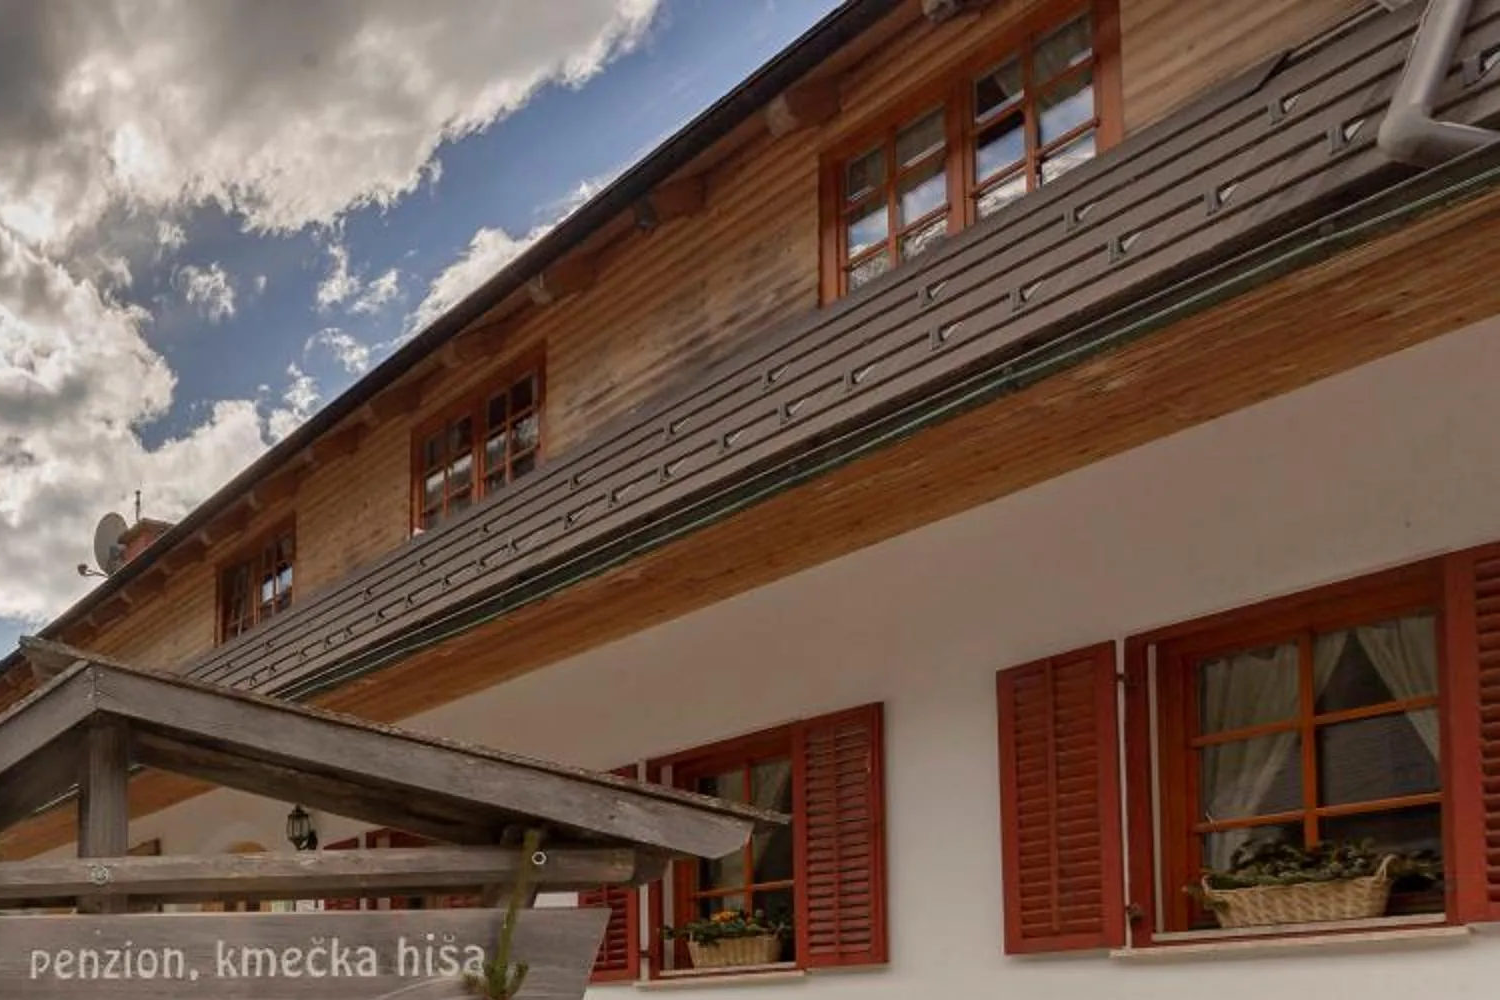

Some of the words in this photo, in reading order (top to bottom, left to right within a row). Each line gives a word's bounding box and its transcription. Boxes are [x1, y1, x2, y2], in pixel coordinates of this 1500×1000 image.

[30, 940, 199, 981] penzion,
[216, 936, 377, 977] kmečka
[398, 932, 485, 977] hiša
